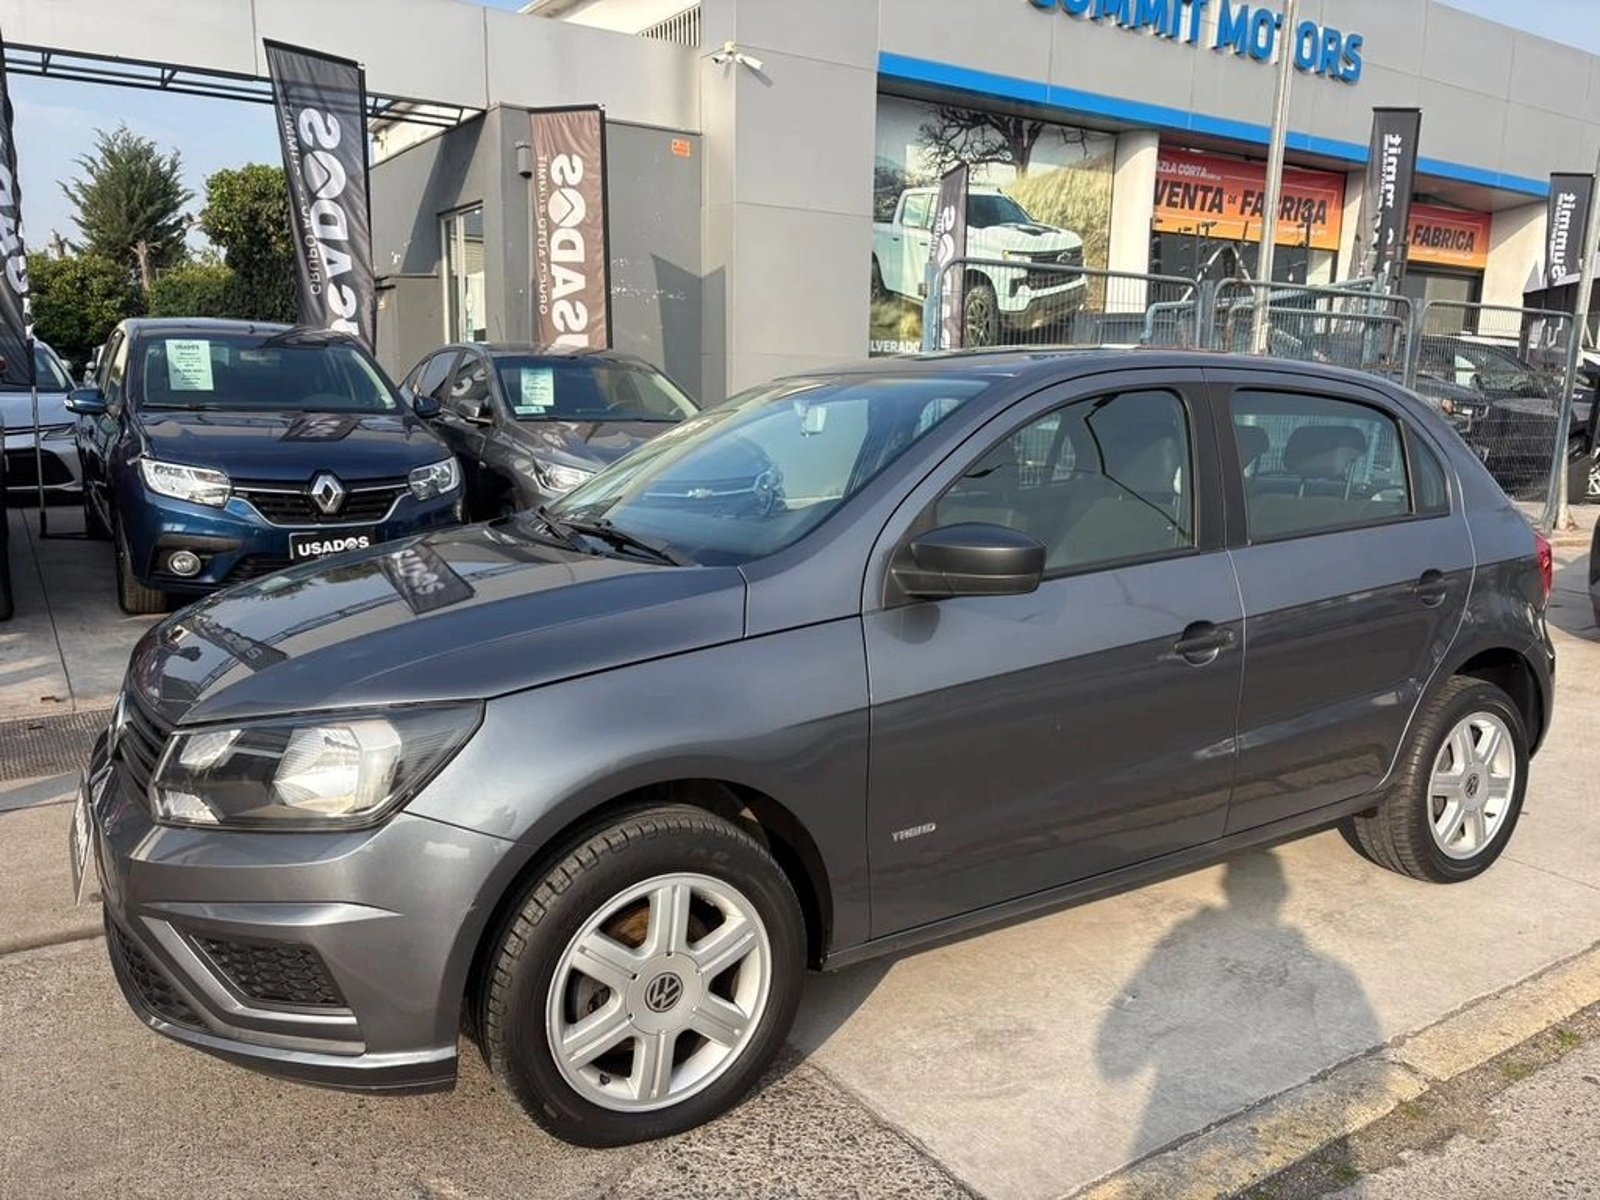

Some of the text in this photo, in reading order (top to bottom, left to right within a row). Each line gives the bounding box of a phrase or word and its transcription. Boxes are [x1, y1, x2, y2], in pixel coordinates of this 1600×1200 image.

[1028, 0, 1363, 85] MMIT MOORS
[1155, 179, 1224, 214] VENTA
[1240, 189, 1328, 226] FARICA
[1412, 224, 1475, 252] FABRICA
[871, 340, 922, 354] LVERADO
[297, 536, 370, 556] USADOS
